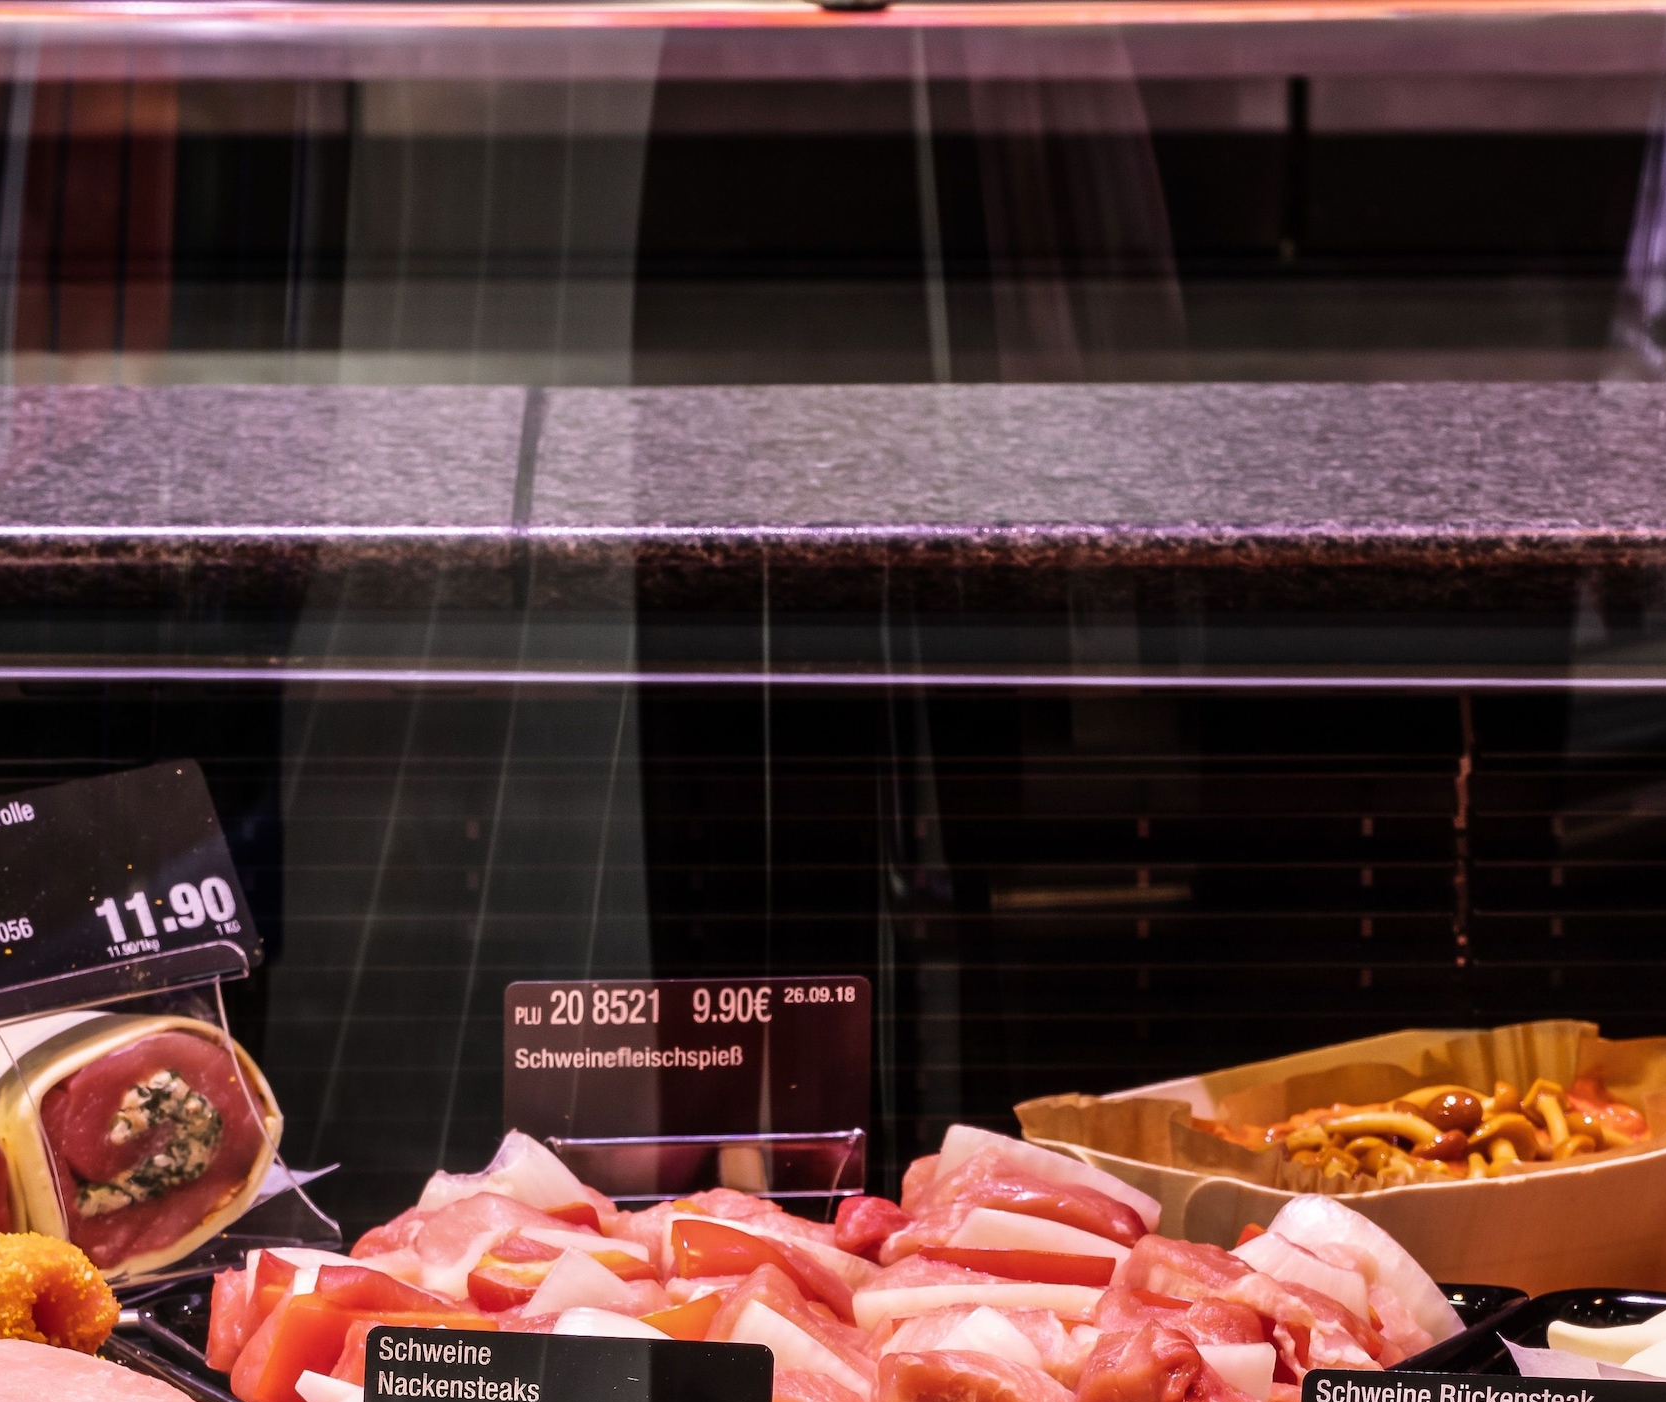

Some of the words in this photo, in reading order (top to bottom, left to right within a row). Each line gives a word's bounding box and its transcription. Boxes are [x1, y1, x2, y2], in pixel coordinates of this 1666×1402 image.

[95, 877, 237, 943] 11.90
[515, 1006, 542, 1025] PLU
[550, 990, 584, 1025] 20
[592, 989, 659, 1025] 8521
[693, 986, 772, 1023] 9.90€
[784, 986, 855, 1003] 26.09.18
[515, 1046, 743, 1070] Schweinefleischspieß
[379, 1336, 491, 1365] Schweine
[378, 1371, 540, 1402] Nackensteaks
